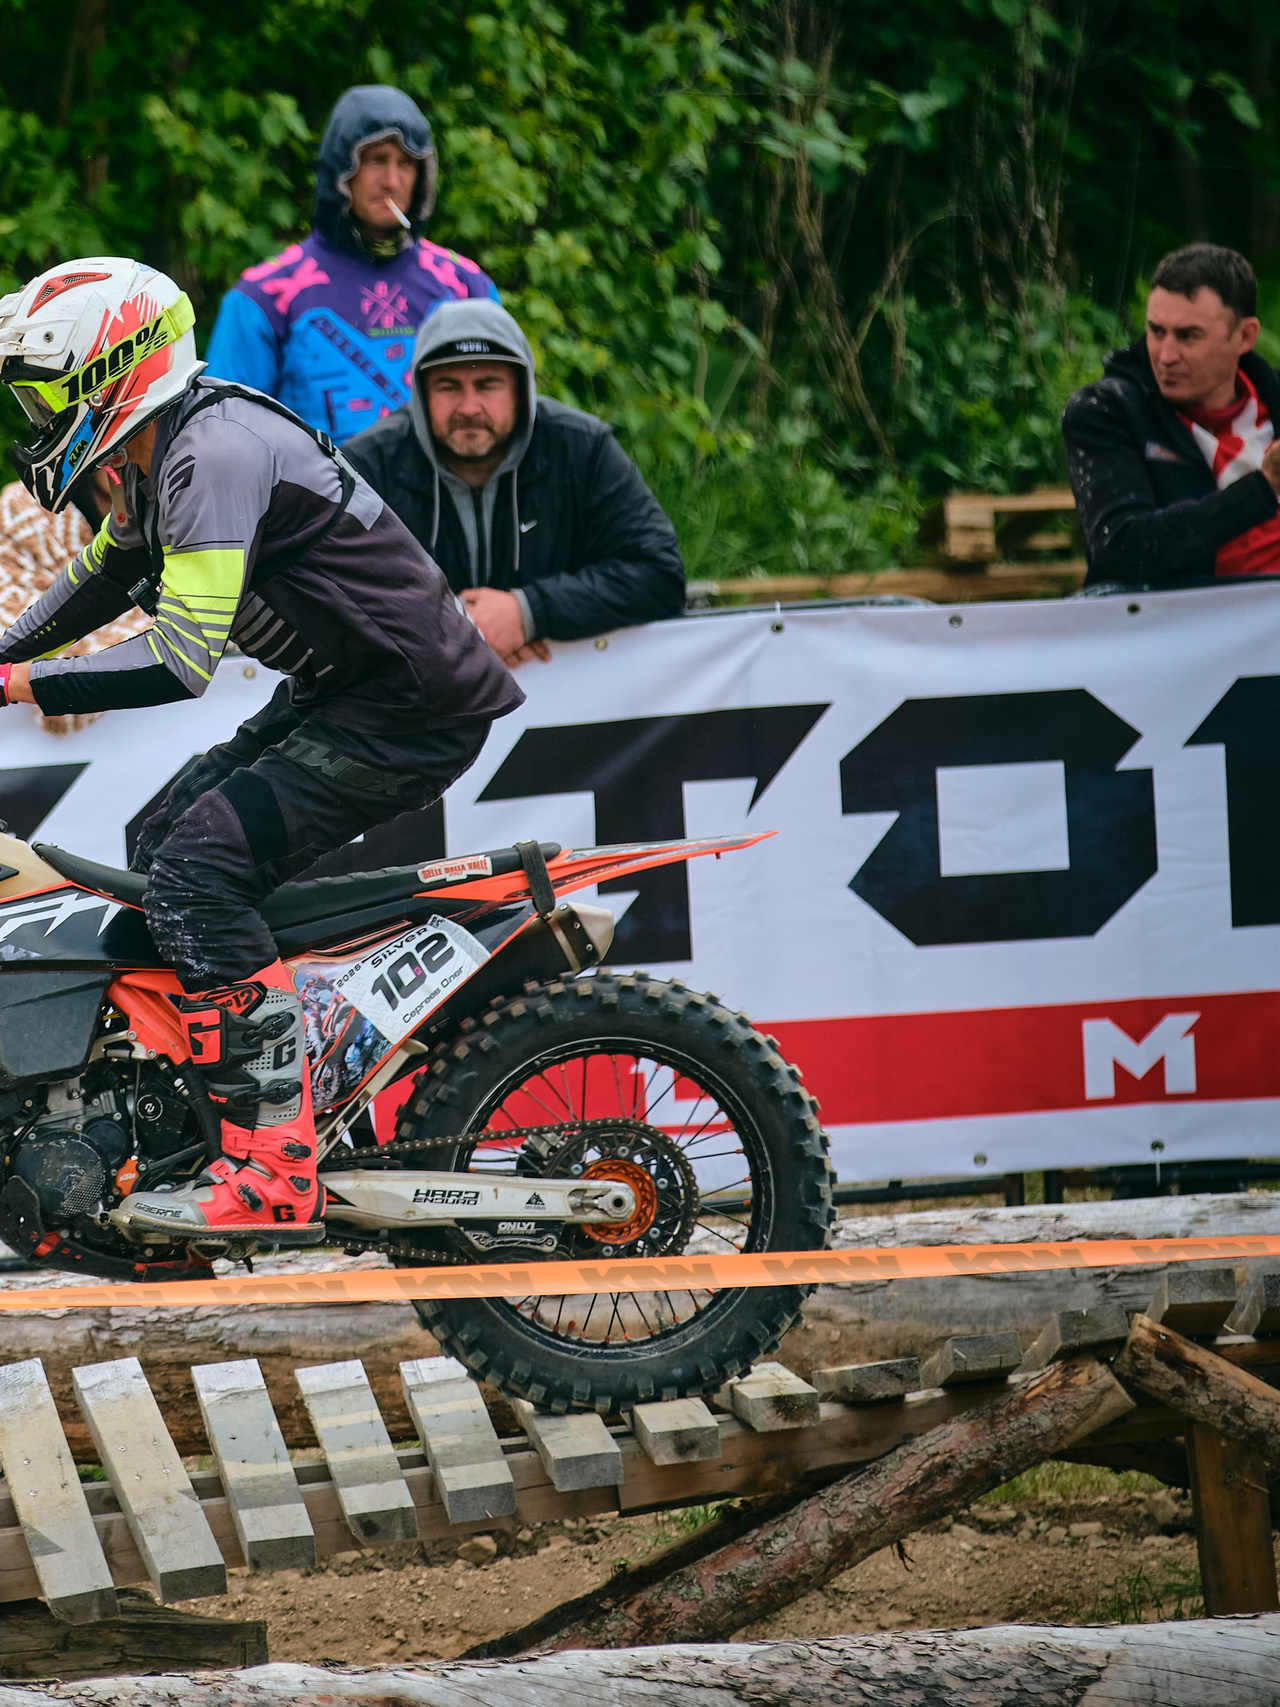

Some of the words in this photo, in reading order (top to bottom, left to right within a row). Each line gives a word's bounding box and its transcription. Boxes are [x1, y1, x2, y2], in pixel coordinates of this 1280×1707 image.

[61, 317, 168, 403] 100%
[68, 439, 89, 468] KTM
[422, 867, 442, 879] SELLE
[371, 932, 455, 1011] 102
[412, 1197, 479, 1206] ENDURO
[414, 1189, 480, 1199] HARD
